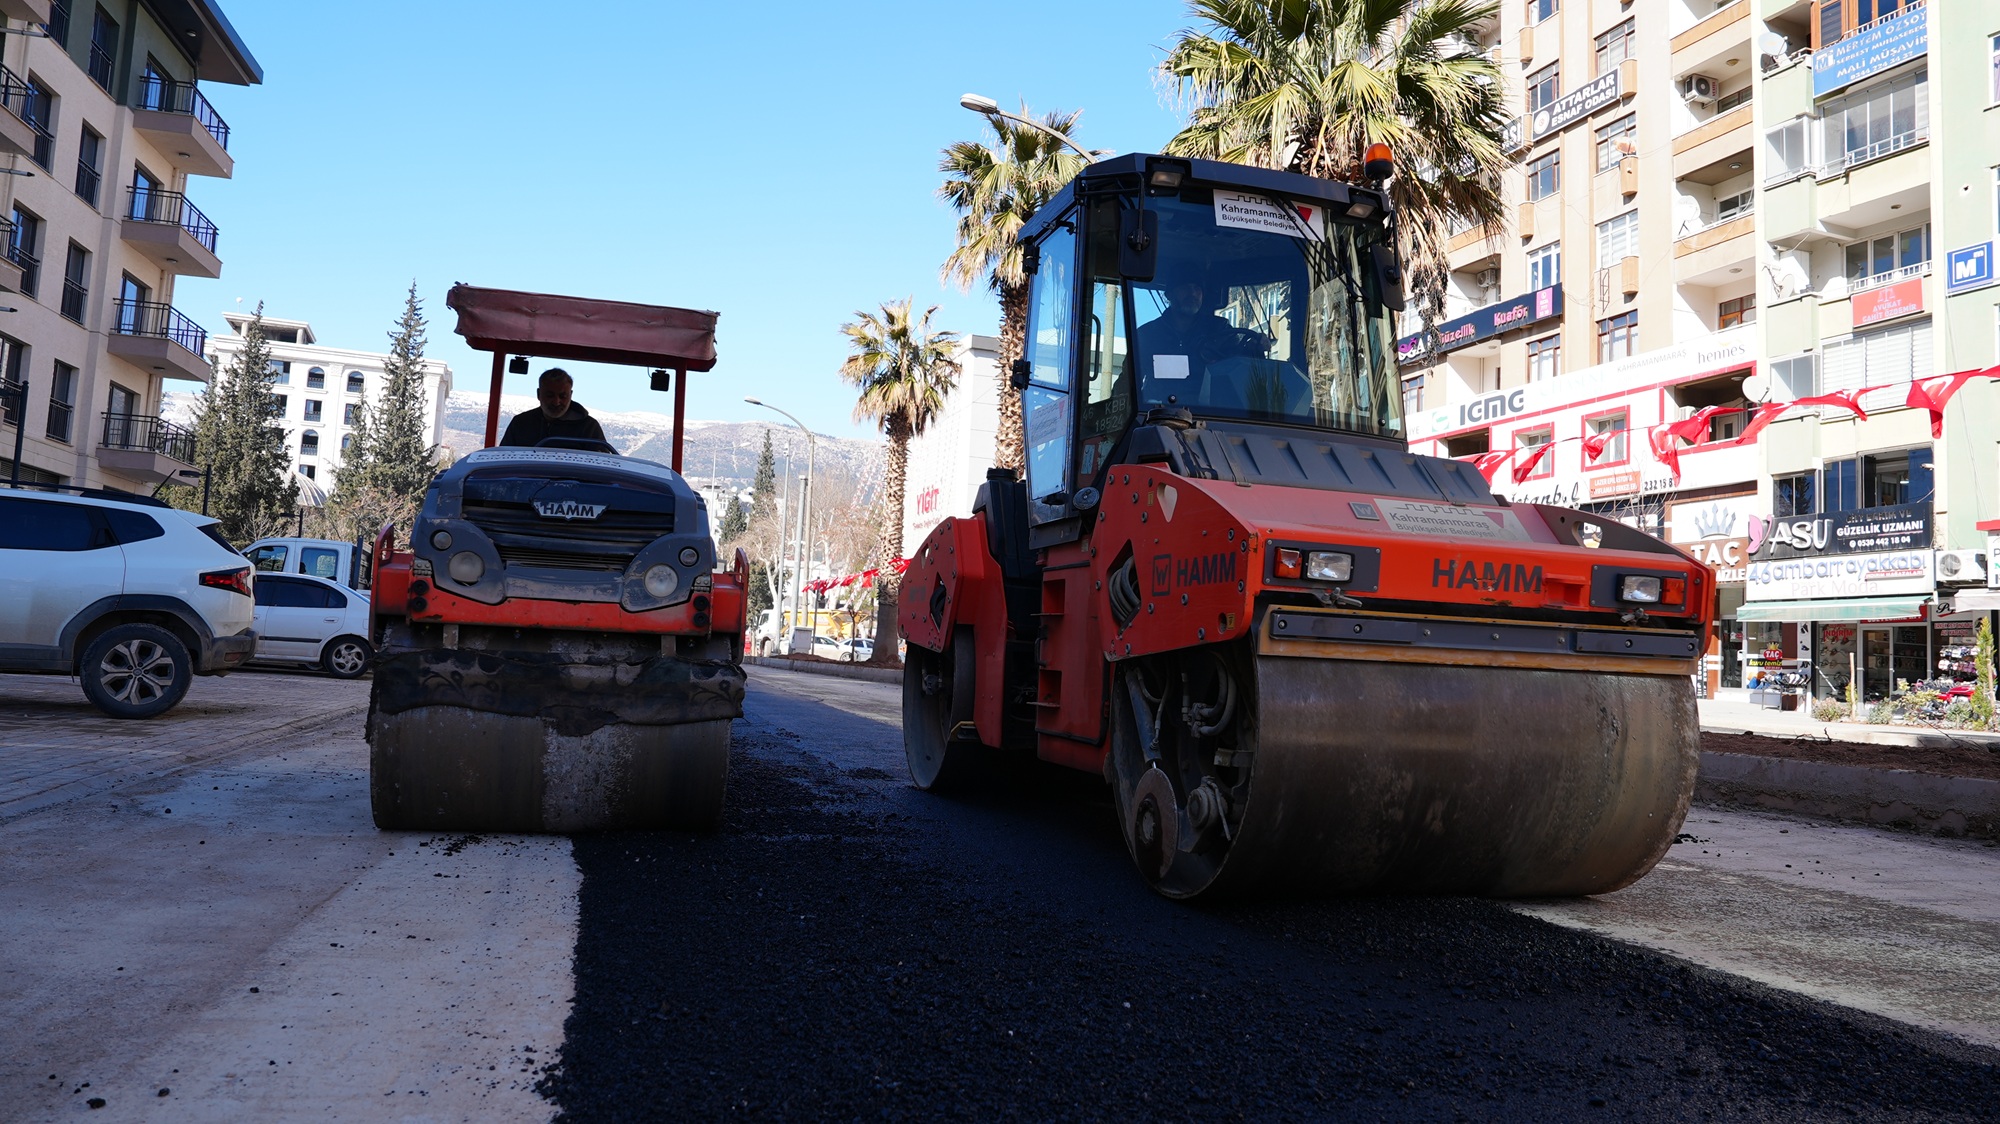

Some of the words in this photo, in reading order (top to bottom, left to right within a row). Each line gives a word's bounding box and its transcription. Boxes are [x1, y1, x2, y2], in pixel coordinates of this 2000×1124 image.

[1836, 31, 1882, 57] MERYEM
[1872, 23, 1927, 50] MUHASEBEC
[1837, 57, 1866, 78] MALİ
[1553, 73, 1615, 116] ATTARLAR
[1551, 104, 1583, 127] ESNAF
[1585, 86, 1616, 110] ODASI
[1222, 213, 1262, 225] Büyükşehir
[1873, 299, 1901, 313] AVUKAT
[1437, 323, 1475, 345] üzellik
[1493, 304, 1528, 326] Kuaför
[1617, 349, 1687, 373] KAHRAMANMARAŞ
[1697, 344, 1746, 365] hennes
[1105, 399, 1127, 415] KBB
[1459, 389, 1524, 426] IGMG
[1644, 479, 1658, 491] 232
[543, 502, 594, 517] HAMM
[1389, 511, 1490, 529] Kahramanmaraş
[1396, 523, 1448, 535] Büyükşehir
[1449, 528, 1495, 538] Belediyesi
[1836, 524, 1880, 537] GÜZELLİK
[1882, 520, 1923, 532] UZMANI
[1857, 539, 1875, 547] 0530
[1876, 537, 1889, 545] 442
[1891, 536, 1900, 544] 18
[1901, 535, 1911, 543] 04
[1691, 541, 1740, 567] TAÇ
[1176, 552, 1236, 587] HAMM
[1432, 558, 1543, 594] HAMM
[1845, 553, 1926, 581] ayakkabı
[1791, 582, 1825, 597] Park
[1831, 580, 1879, 596] Moda
[1765, 650, 1780, 660] TAÇ
